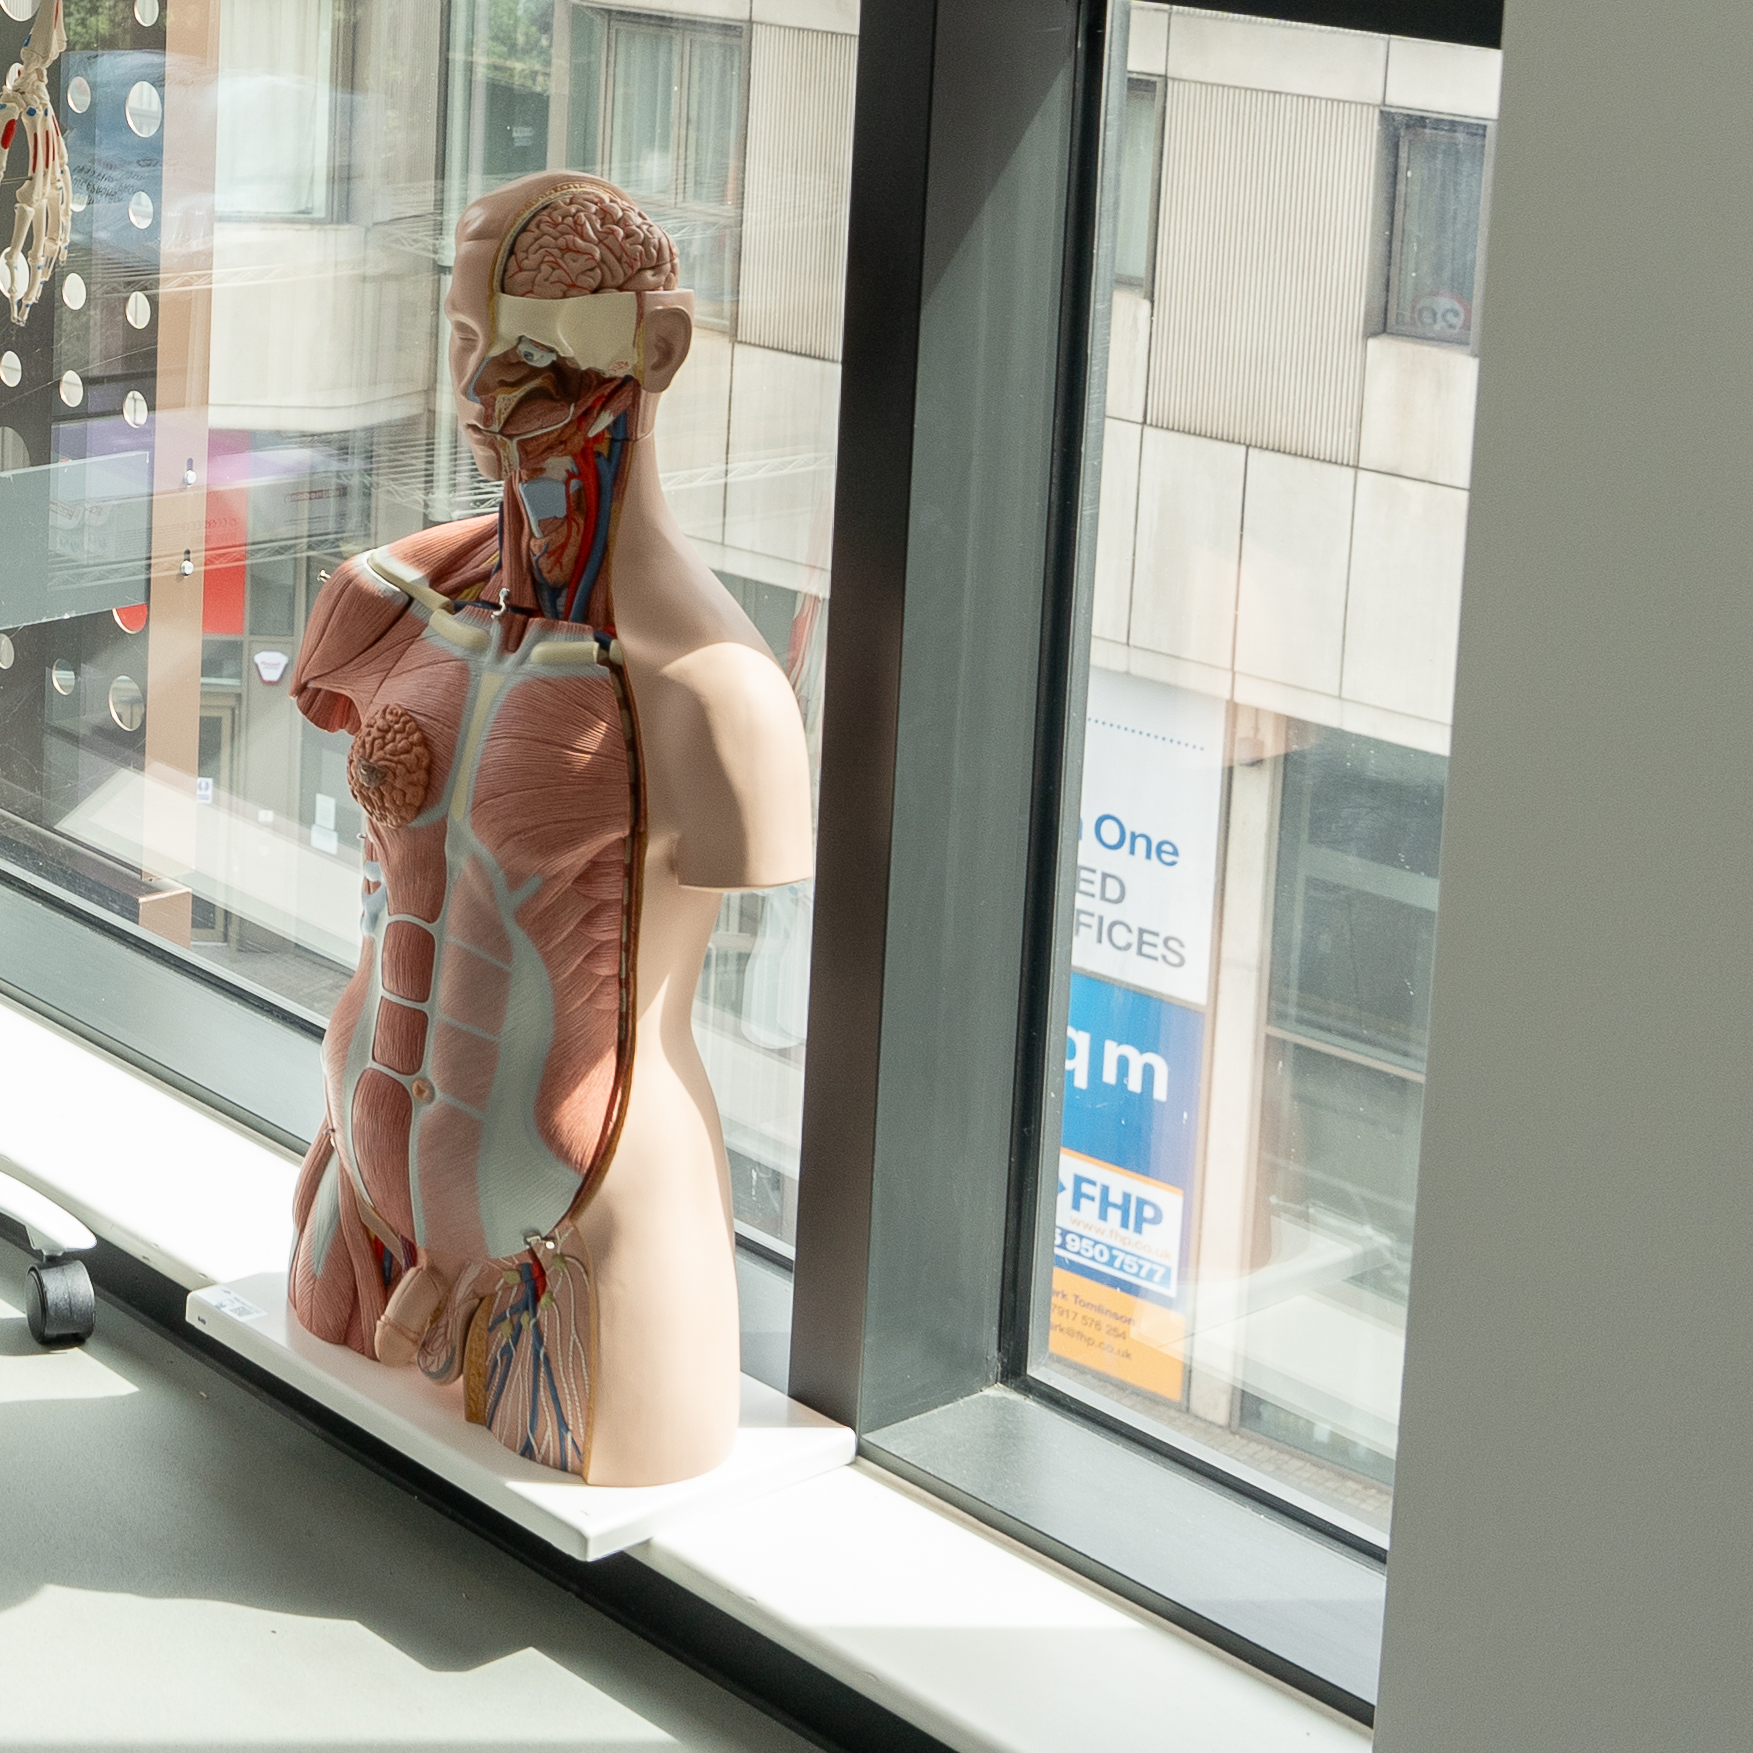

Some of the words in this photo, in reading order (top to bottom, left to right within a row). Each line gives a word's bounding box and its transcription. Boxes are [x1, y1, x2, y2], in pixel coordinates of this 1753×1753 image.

[1094, 813, 1180, 867] One
[1071, 1173, 1163, 1236] FHP
[1065, 1233, 1110, 1263] 950
[1112, 1248, 1166, 1283] 7577
[1073, 1294, 1135, 1325] Tomlinson
